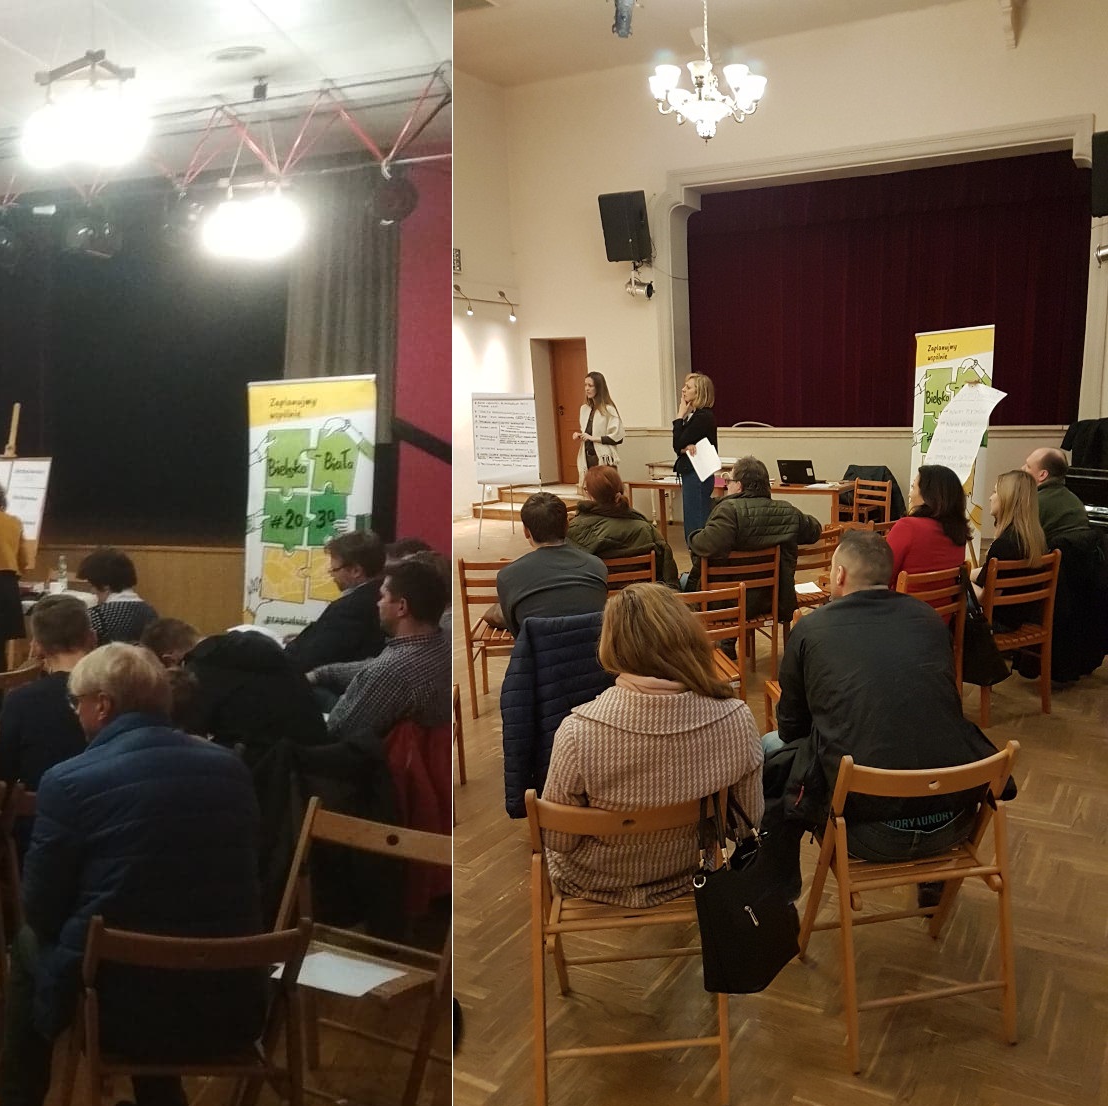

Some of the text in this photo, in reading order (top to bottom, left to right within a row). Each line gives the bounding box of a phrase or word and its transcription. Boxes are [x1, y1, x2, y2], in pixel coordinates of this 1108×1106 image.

[927, 343, 958, 352] Zaplanujmy
[927, 353, 948, 362] wspólnie
[925, 390, 950, 406] Bielsko
[267, 458, 307, 478] Bielsko
[270, 509, 336, 530] #20 30
